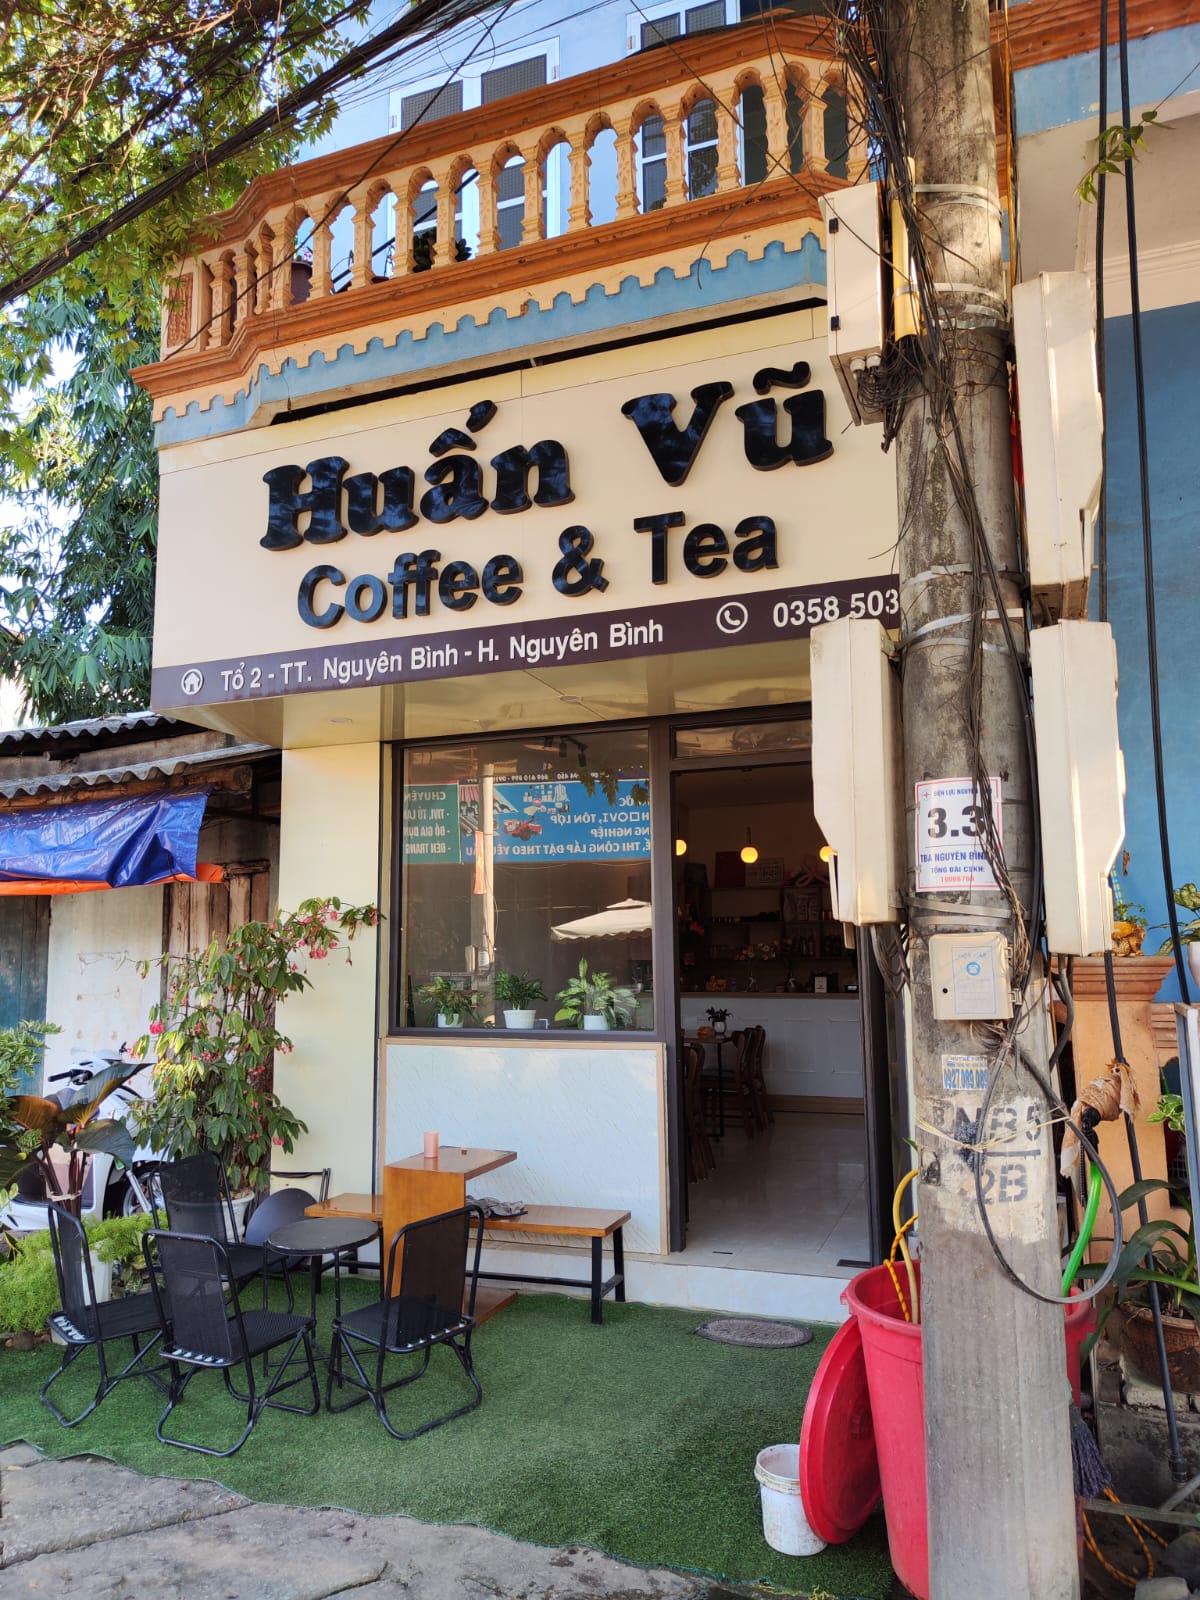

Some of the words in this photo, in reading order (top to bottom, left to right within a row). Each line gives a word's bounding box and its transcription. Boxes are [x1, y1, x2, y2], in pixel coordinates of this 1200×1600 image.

[259, 400, 575, 551] Huấn
[621, 361, 834, 487] Vũ
[298, 549, 523, 629] Coffee
[552, 525, 610, 597] &
[634, 511, 779, 584] Tea
[773, 596, 839, 628] 0358
[221, 661, 245, 692] Tổ
[250, 667, 261, 688] 2
[280, 661, 312, 685] TT.
[323, 650, 402, 684] Nguyên
[411, 644, 458, 670] Bình
[478, 639, 499, 662] H.
[510, 628, 598, 662] Nguyên
[610, 619, 663, 647] Bình
[928, 805, 986, 838] 3.3
